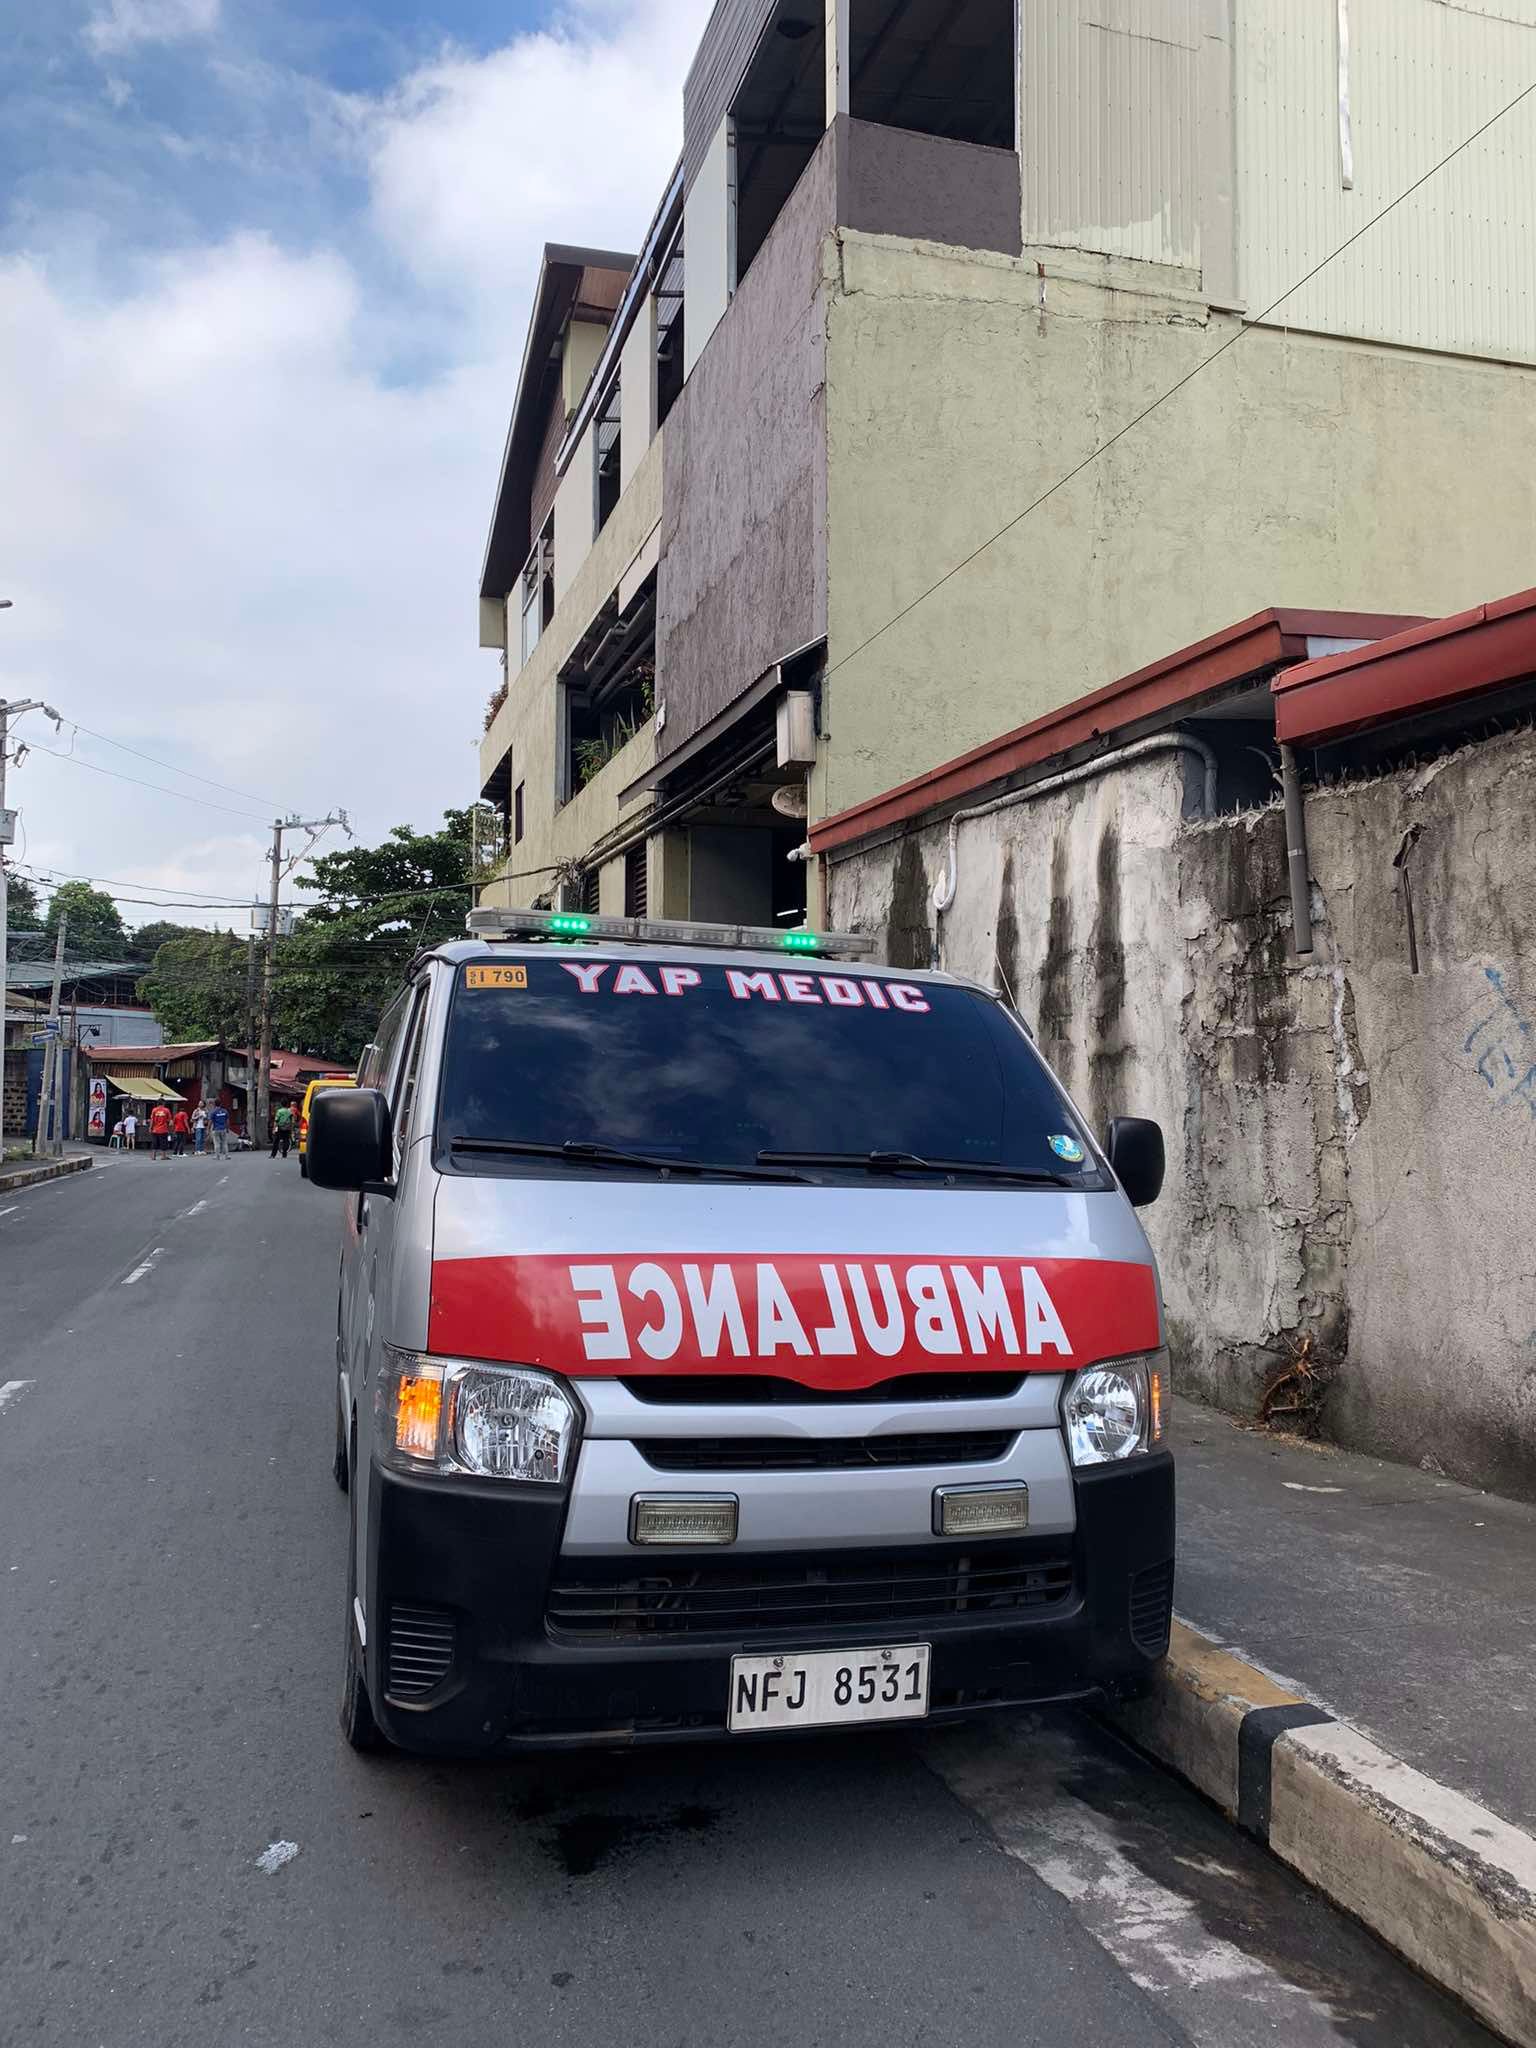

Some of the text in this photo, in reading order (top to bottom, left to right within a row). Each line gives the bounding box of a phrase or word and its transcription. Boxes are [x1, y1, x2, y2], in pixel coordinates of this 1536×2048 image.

[493, 970, 525, 982] 790
[560, 962, 931, 1013] YAP MEDIC
[736, 1661, 922, 1714] NFJ 8531
